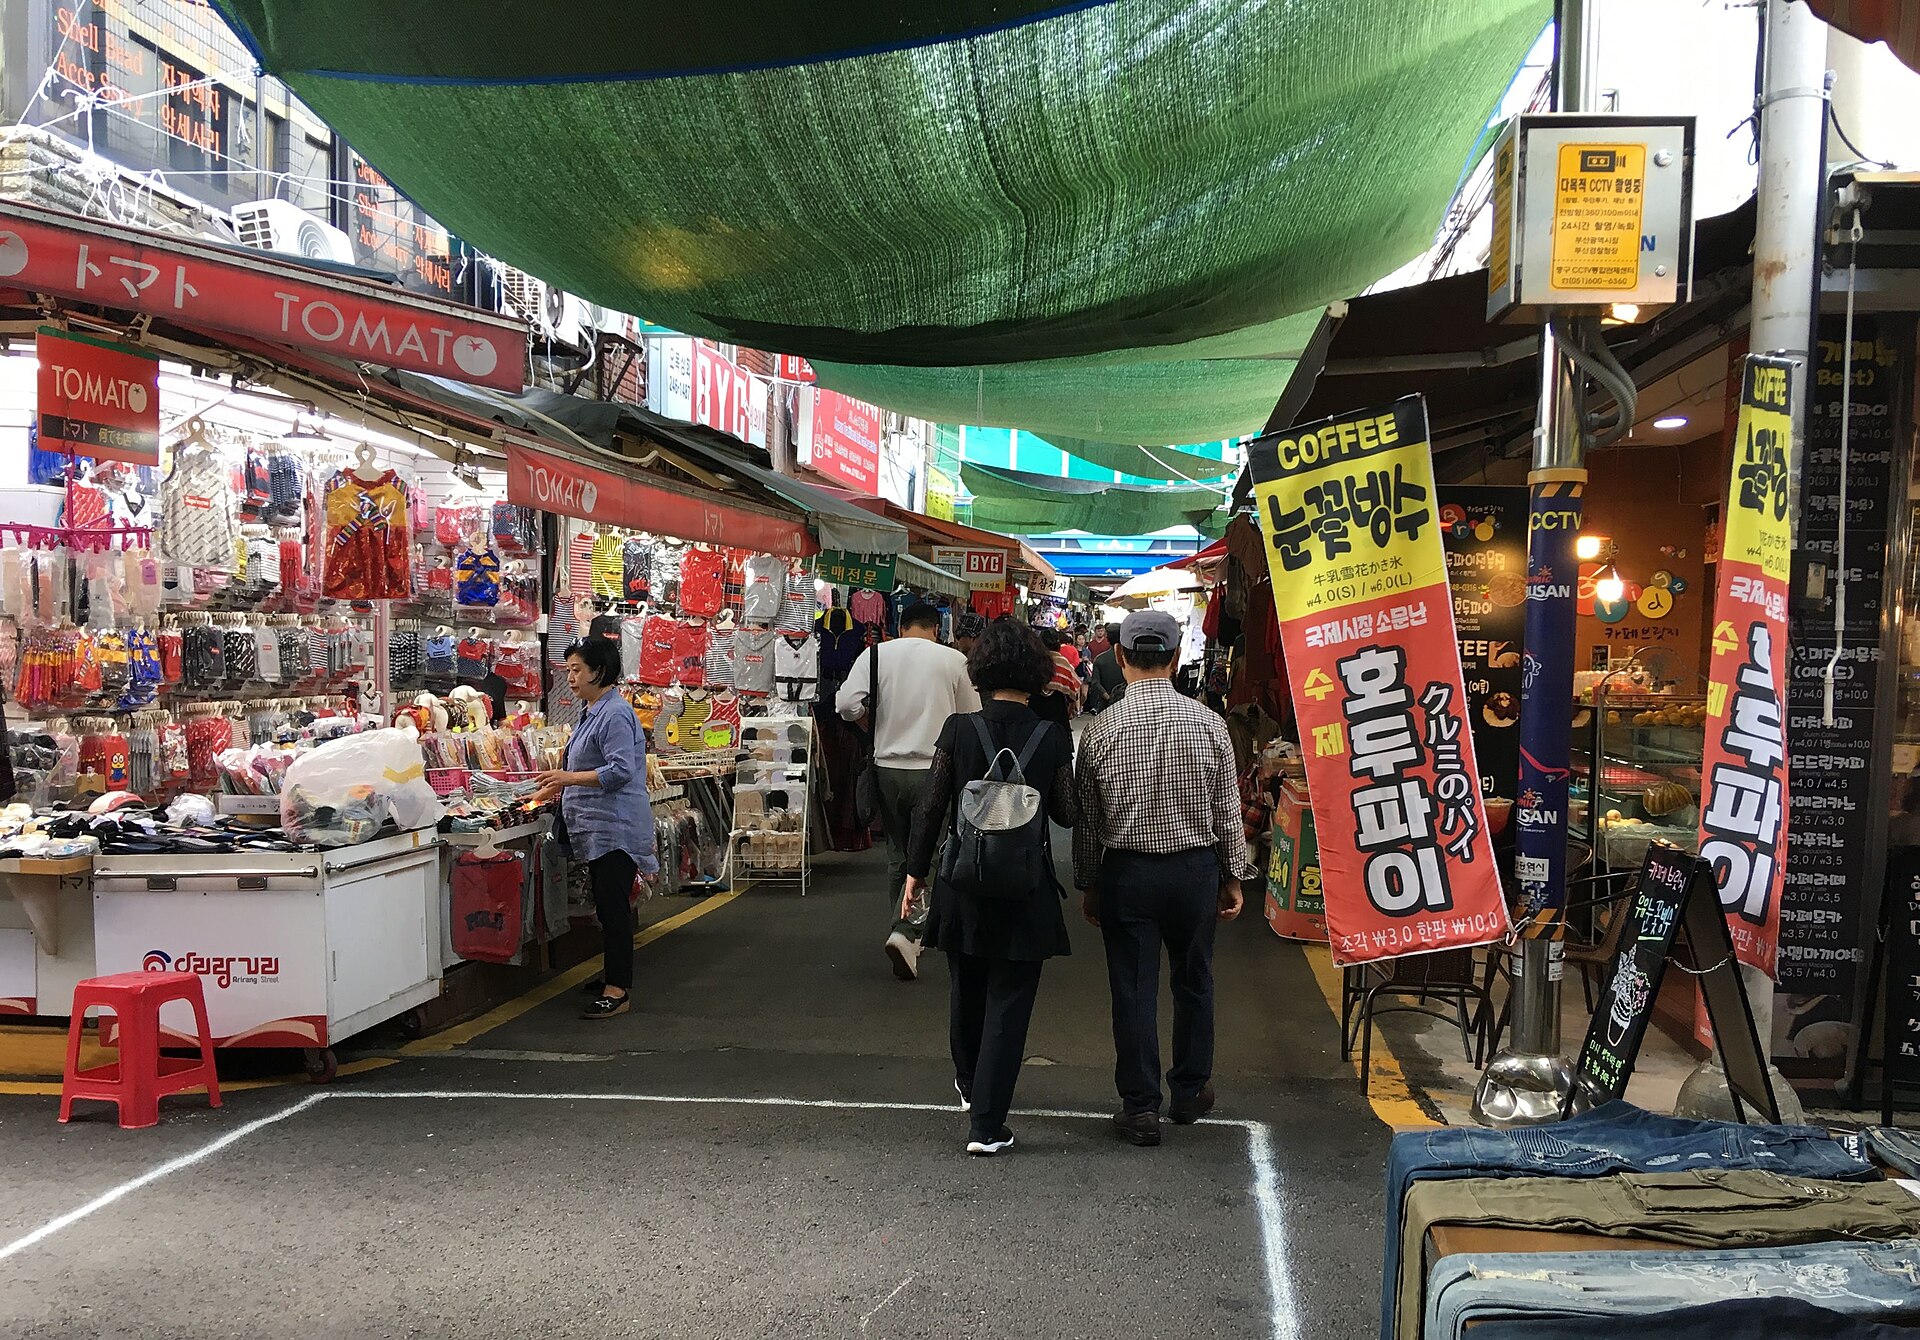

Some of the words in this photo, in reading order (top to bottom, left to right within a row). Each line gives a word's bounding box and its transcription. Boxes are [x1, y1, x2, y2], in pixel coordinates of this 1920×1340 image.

[57, 7, 99, 53] Shell
[1561, 178, 1587, 193] 다목적
[1590, 178, 1613, 192] CCTV
[1615, 178, 1641, 193] 촬영중
[1561, 222, 1590, 231] 24시간
[76, 243, 200, 310] トマト
[696, 352, 749, 443] BYC
[62, 420, 89, 441] トマト
[1277, 413, 1399, 470] COFFEE
[1268, 463, 1430, 571] 눈꽃빙수
[1531, 511, 1582, 530] CCTV
[970, 554, 999, 572] BYC
[1446, 549, 1506, 570] 두파이전문점
[815, 563, 878, 586] 도매전문
[1313, 556, 1404, 586] 牛乳雪花かき氷
[1039, 577, 1067, 593] 삼진사
[1454, 596, 1493, 615] 호두파이
[1305, 614, 1374, 648] 국제시장
[1376, 601, 1428, 634] 소문난
[1788, 754, 1865, 770] 드드립커피
[1340, 648, 1447, 912] 호두파이
[1421, 684, 1476, 861] クルミのパイ
[1790, 796, 1856, 811] 메리카노
[1517, 808, 1557, 825] SAN
[1788, 832, 1845, 847] 카푸치노
[60, 875, 94, 891] トマト
[1784, 872, 1846, 886] 카페라떼
[1780, 909, 1843, 924] 카페모카
[1341, 932, 1369, 953] 조각
[1416, 918, 1447, 943] 한판
[233, 976, 257, 985] Arirang
[260, 976, 280, 984] Street
